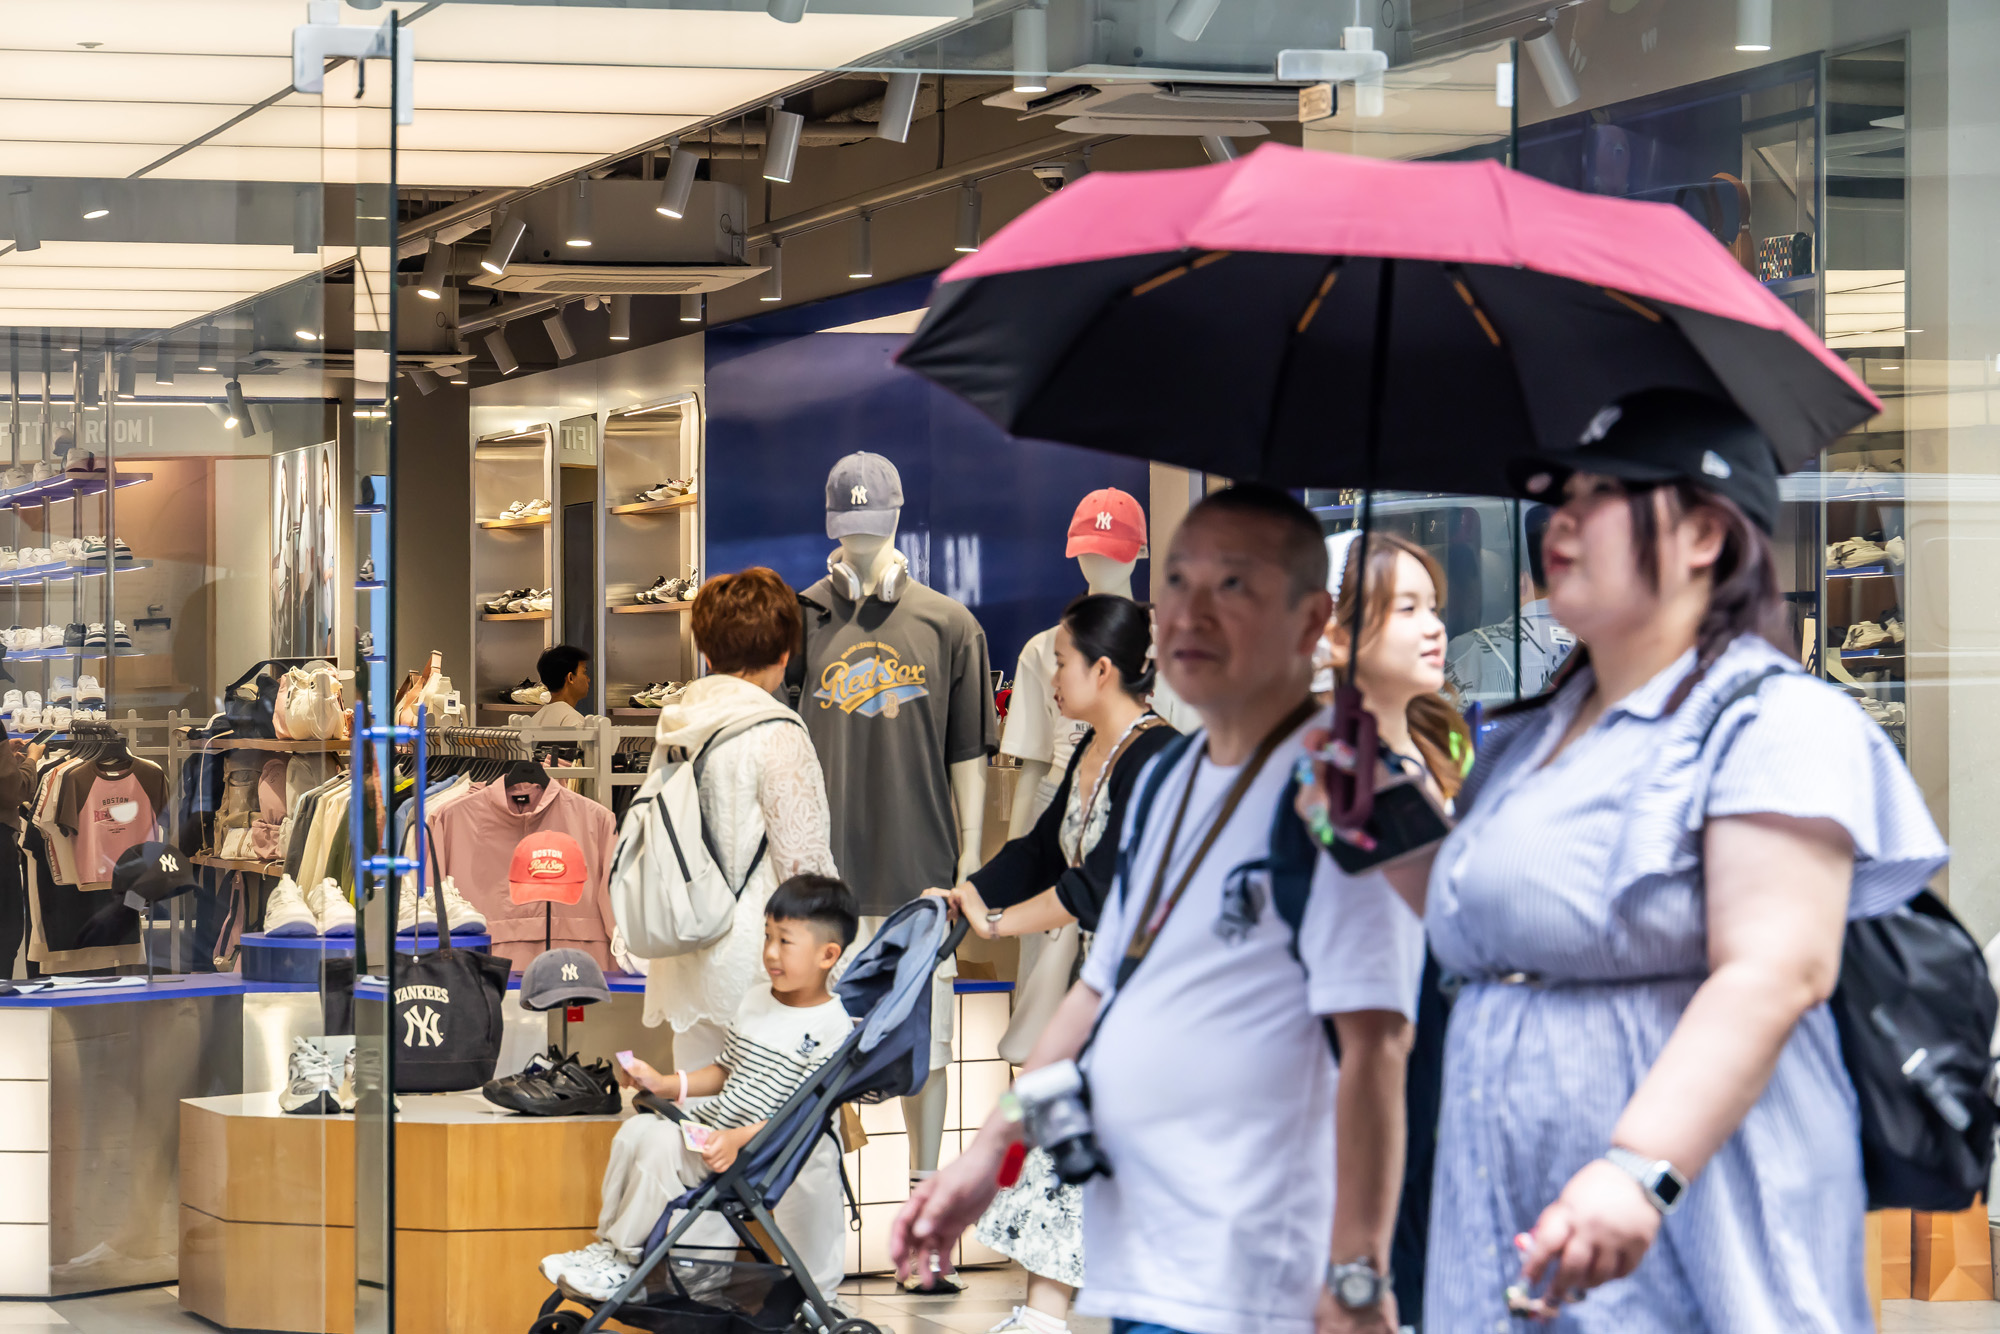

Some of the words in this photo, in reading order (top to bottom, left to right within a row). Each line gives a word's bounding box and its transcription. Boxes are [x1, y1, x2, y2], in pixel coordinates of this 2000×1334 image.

[850, 484, 868, 505] NY
[1095, 511, 1113, 531] NY
[820, 654, 881, 710] Red
[878, 658, 926, 685] Sox
[102, 797, 129, 806] BOSTON
[158, 853, 179, 873] NY
[532, 848, 563, 859] BOSTON
[560, 962, 579, 982] NY
[393, 984, 450, 1005] YANKEES
[402, 1004, 444, 1048] NY
